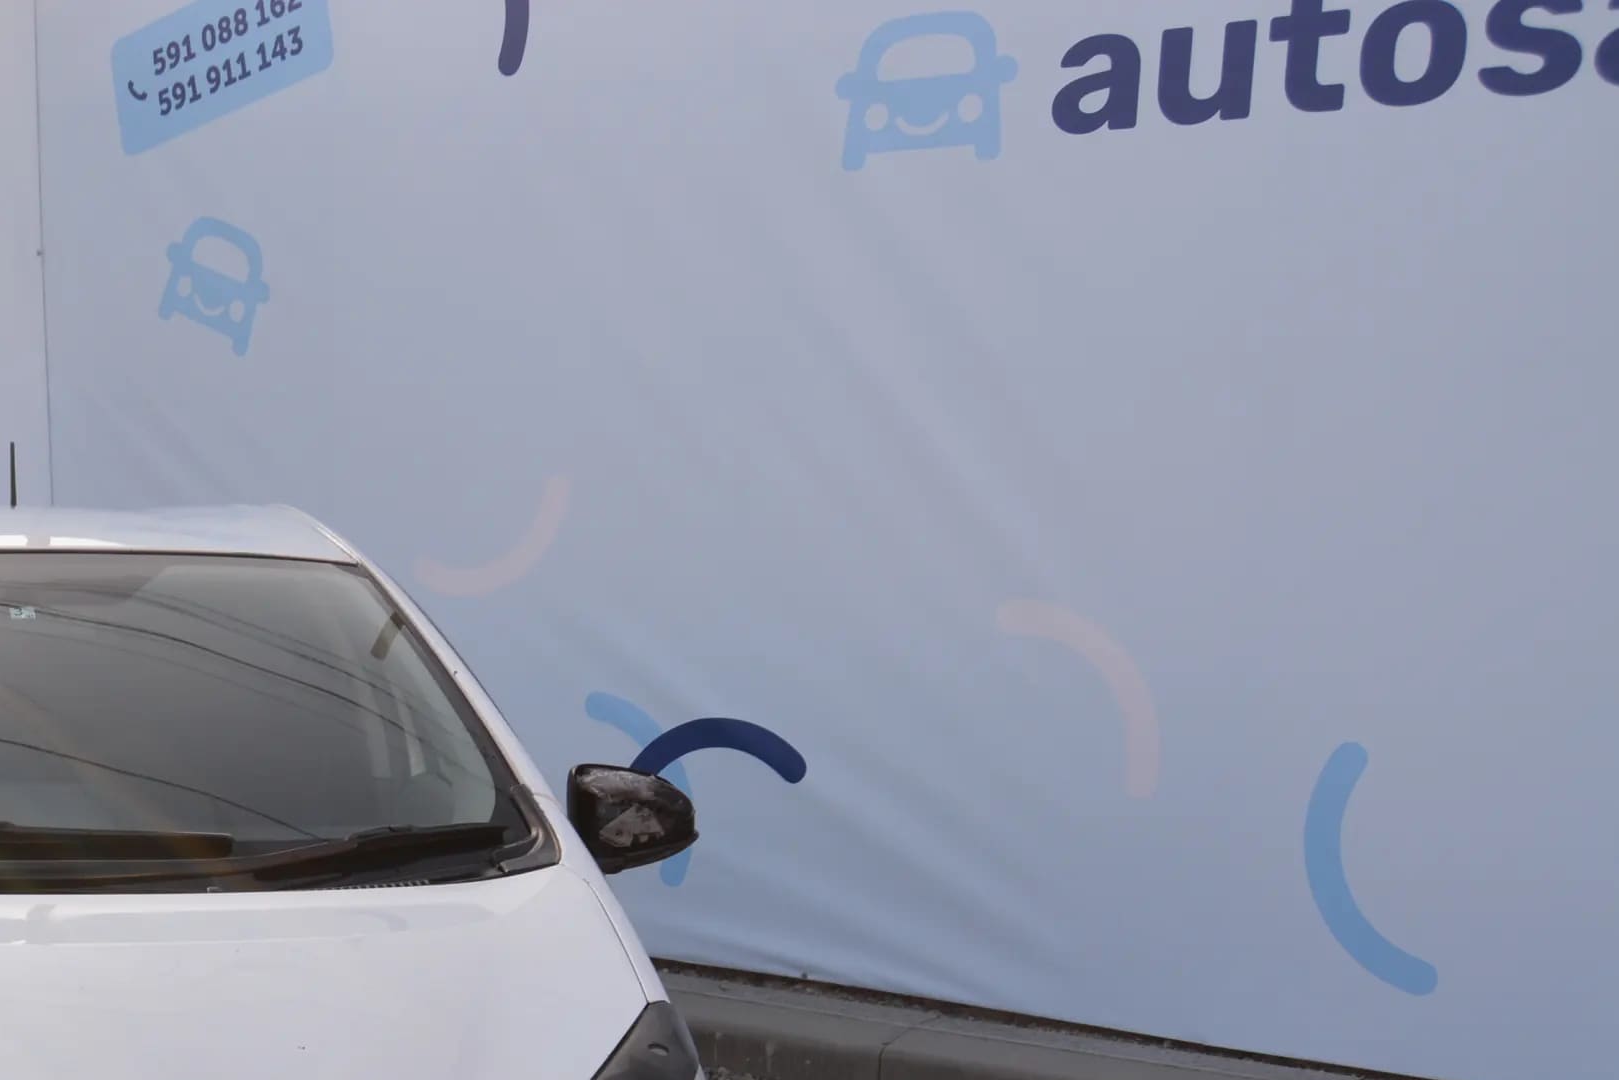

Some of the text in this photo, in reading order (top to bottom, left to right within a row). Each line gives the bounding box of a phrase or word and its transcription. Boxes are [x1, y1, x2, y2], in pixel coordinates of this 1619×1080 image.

[153, 34, 196, 76] 591
[201, 8, 248, 51] 088
[158, 25, 303, 116] 591 911 143
[1051, 0, 1619, 135] autos
